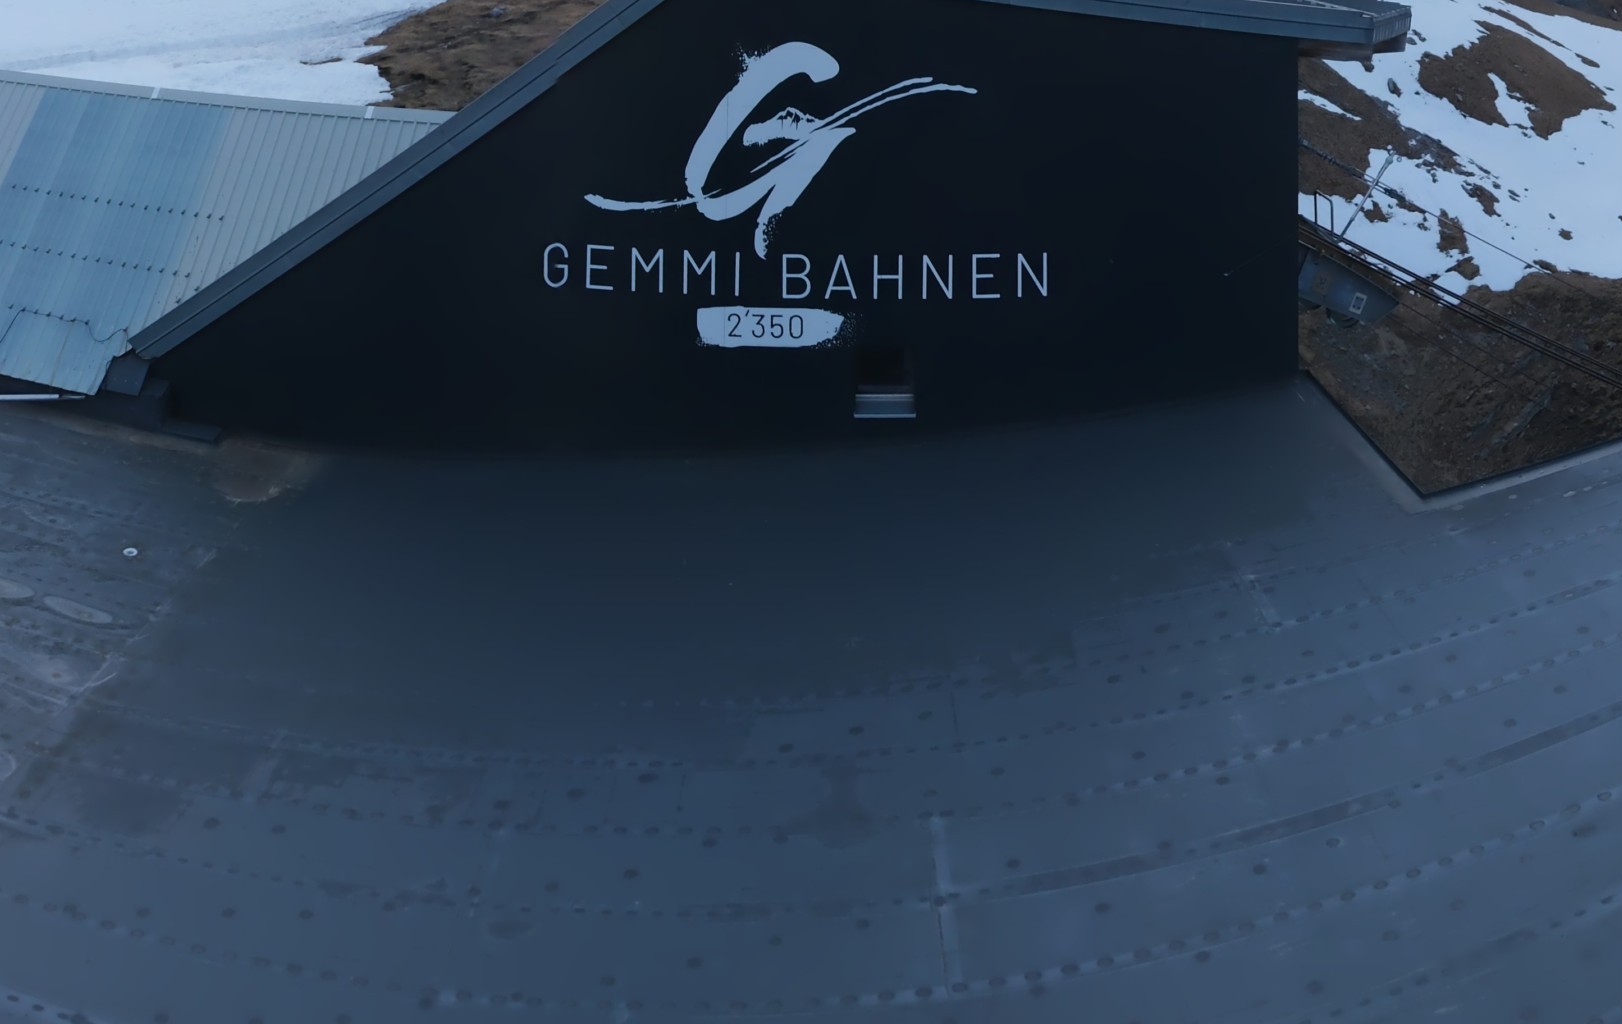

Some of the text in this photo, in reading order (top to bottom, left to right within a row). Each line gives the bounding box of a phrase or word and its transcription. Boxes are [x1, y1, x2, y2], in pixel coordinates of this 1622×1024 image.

[543, 242, 1048, 300] GEMMI BAHNEN
[727, 309, 804, 339] 2'350
